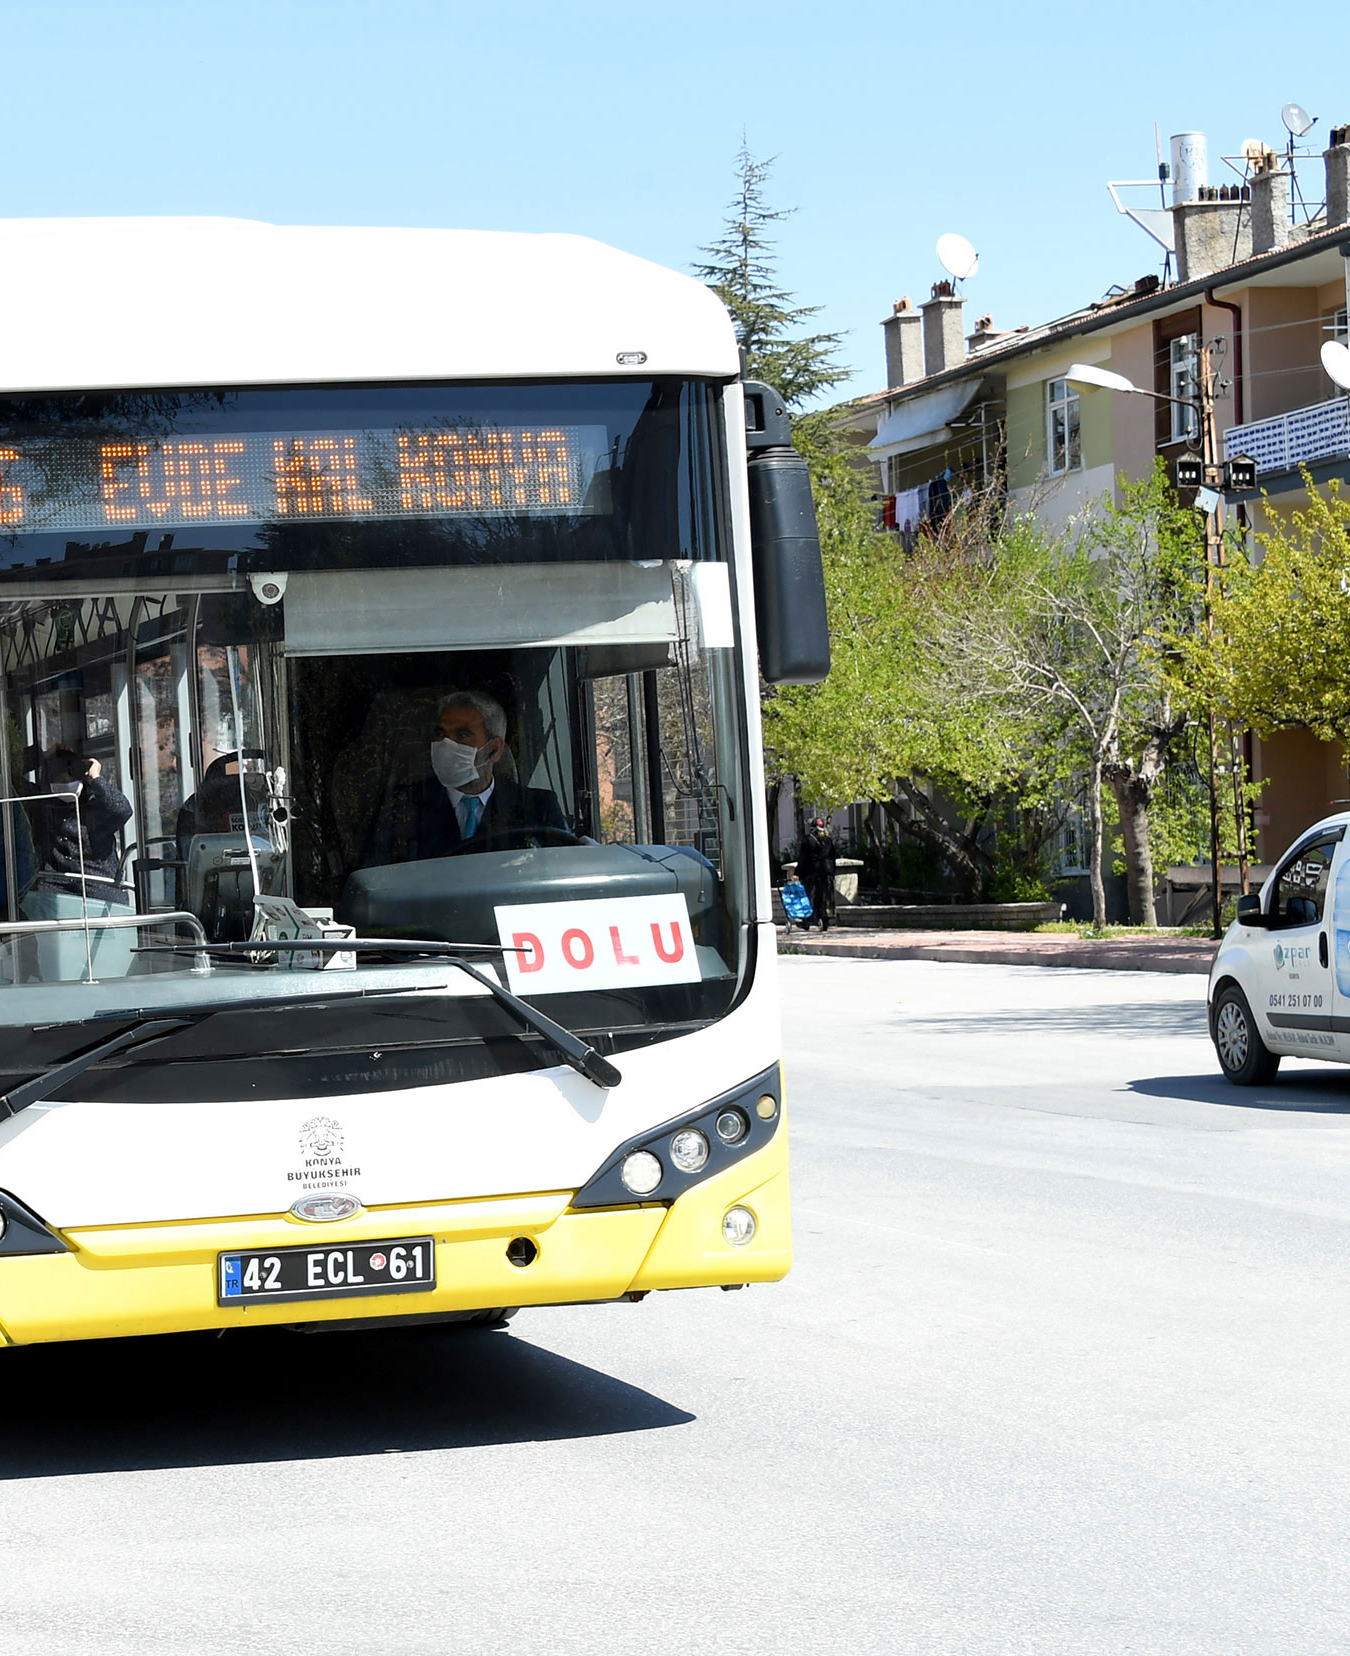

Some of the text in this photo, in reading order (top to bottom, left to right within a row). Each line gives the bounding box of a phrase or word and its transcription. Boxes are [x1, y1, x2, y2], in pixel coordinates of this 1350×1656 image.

[101, 440, 248, 521] EVDE
[511, 921, 685, 974] DOLU
[1269, 994, 1323, 1007] 0541 251 07 00
[305, 1157, 342, 1167] KONYA
[243, 1246, 424, 1291] 42 ECL 61
[226, 1279, 239, 1289] TR
